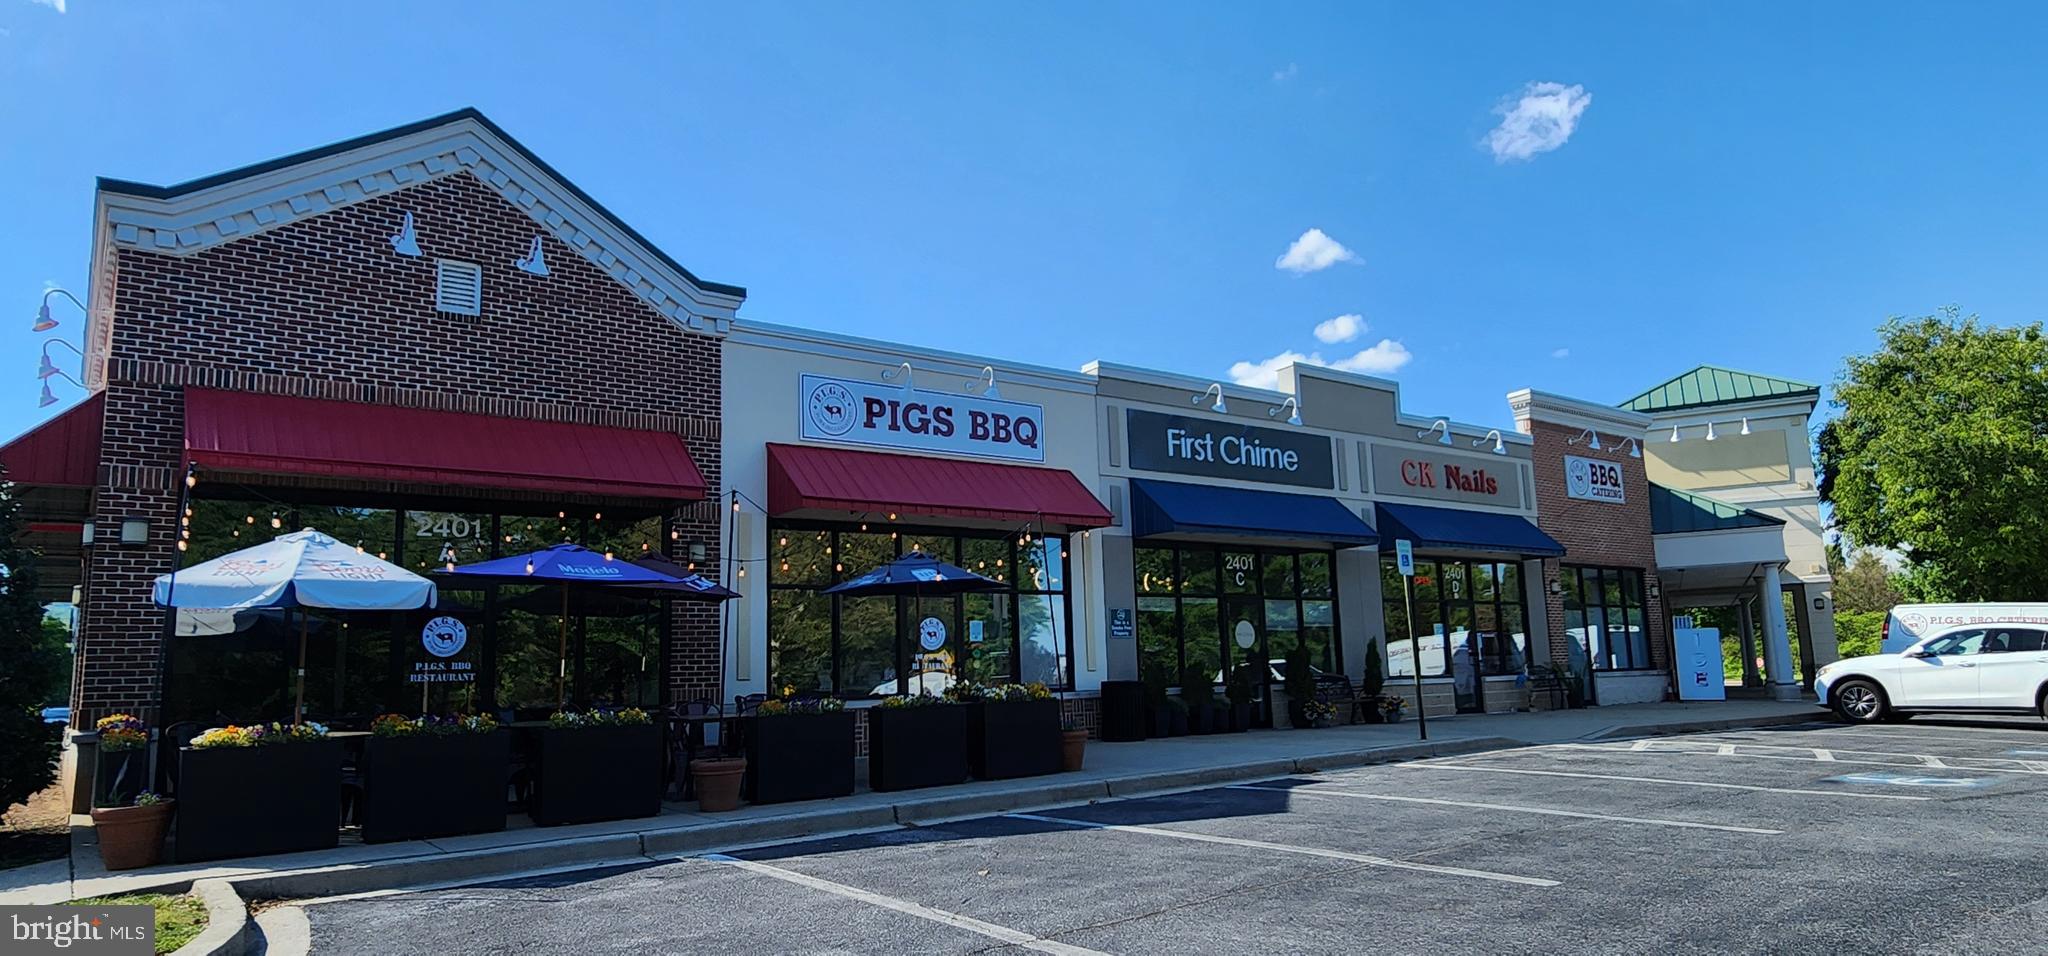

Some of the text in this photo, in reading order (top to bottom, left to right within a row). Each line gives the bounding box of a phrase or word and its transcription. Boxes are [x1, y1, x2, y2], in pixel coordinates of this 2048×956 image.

[863, 397, 955, 437] PIGS
[968, 410, 1038, 449] BBQ
[1167, 428, 1299, 471] First Chime
[1401, 459, 1498, 495] CK Nails
[1589, 463, 1621, 488] BBQ
[1591, 486, 1623, 499] CATERING
[416, 516, 481, 538] 2401
[557, 563, 620, 575] Modelo
[1225, 555, 1254, 570] 2401
[1235, 572, 1245, 586] C
[1444, 567, 1465, 579] 2401
[451, 661, 472, 670] BBQ
[410, 672, 476, 682] RESTAURANT
